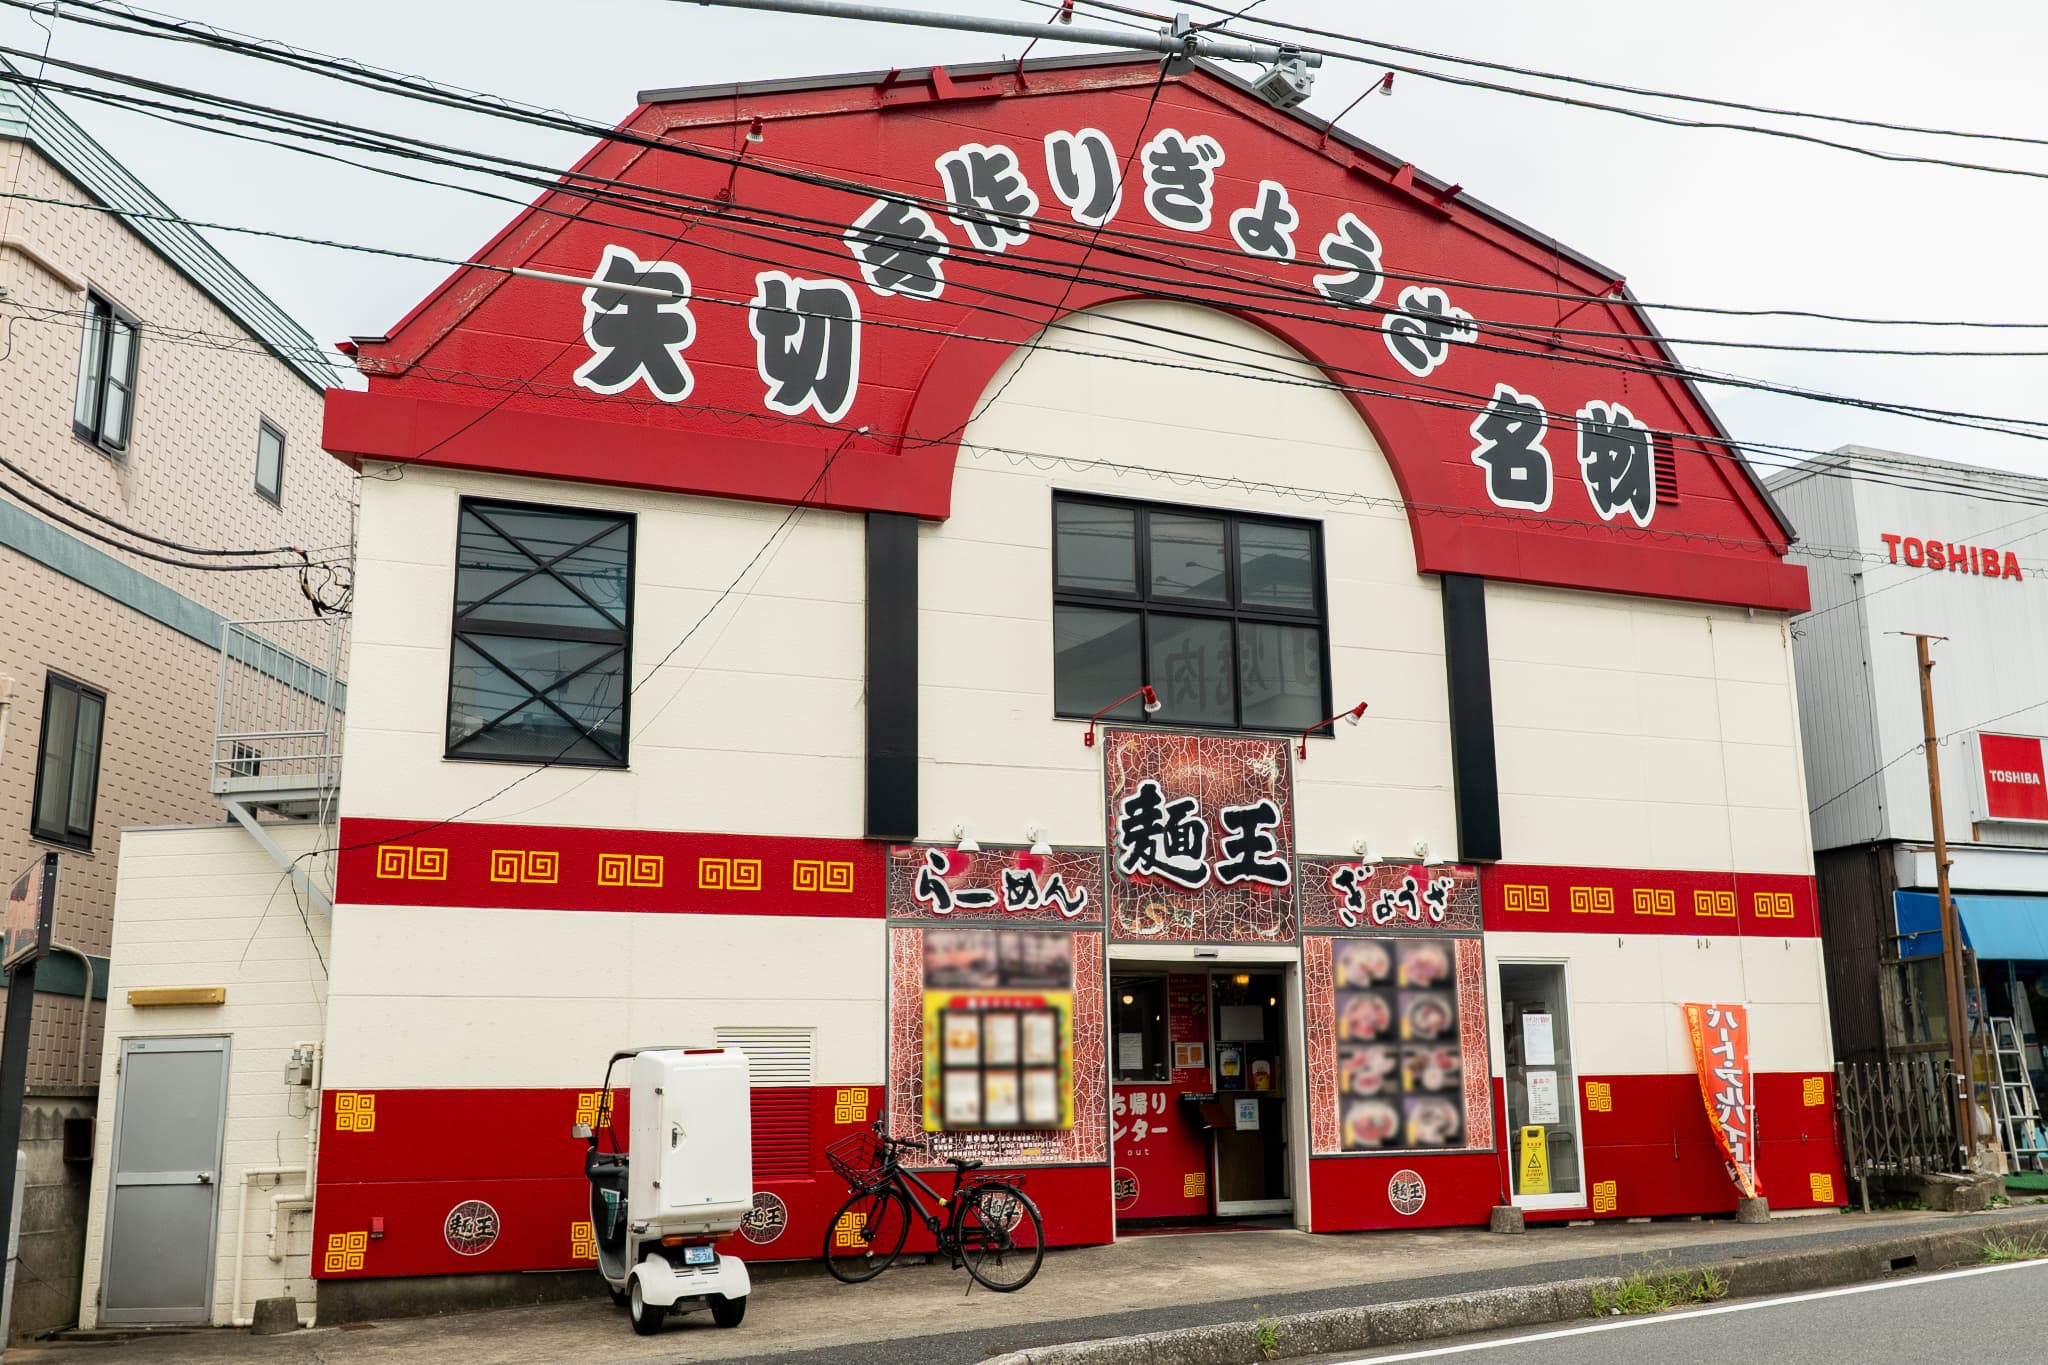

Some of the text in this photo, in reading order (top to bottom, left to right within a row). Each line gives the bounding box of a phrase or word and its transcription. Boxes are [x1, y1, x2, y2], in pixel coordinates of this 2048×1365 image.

[573, 243, 863, 423] 矢切
[1469, 382, 1657, 527] 名物
[1881, 533, 2023, 581] TOSHIBA
[1989, 769, 2040, 785] TOSHIBA
[1116, 779, 1291, 889] 麺王
[915, 847, 1088, 918] らーめん
[1332, 864, 1454, 927] ぎょうざ
[1127, 1148, 1150, 1156] out
